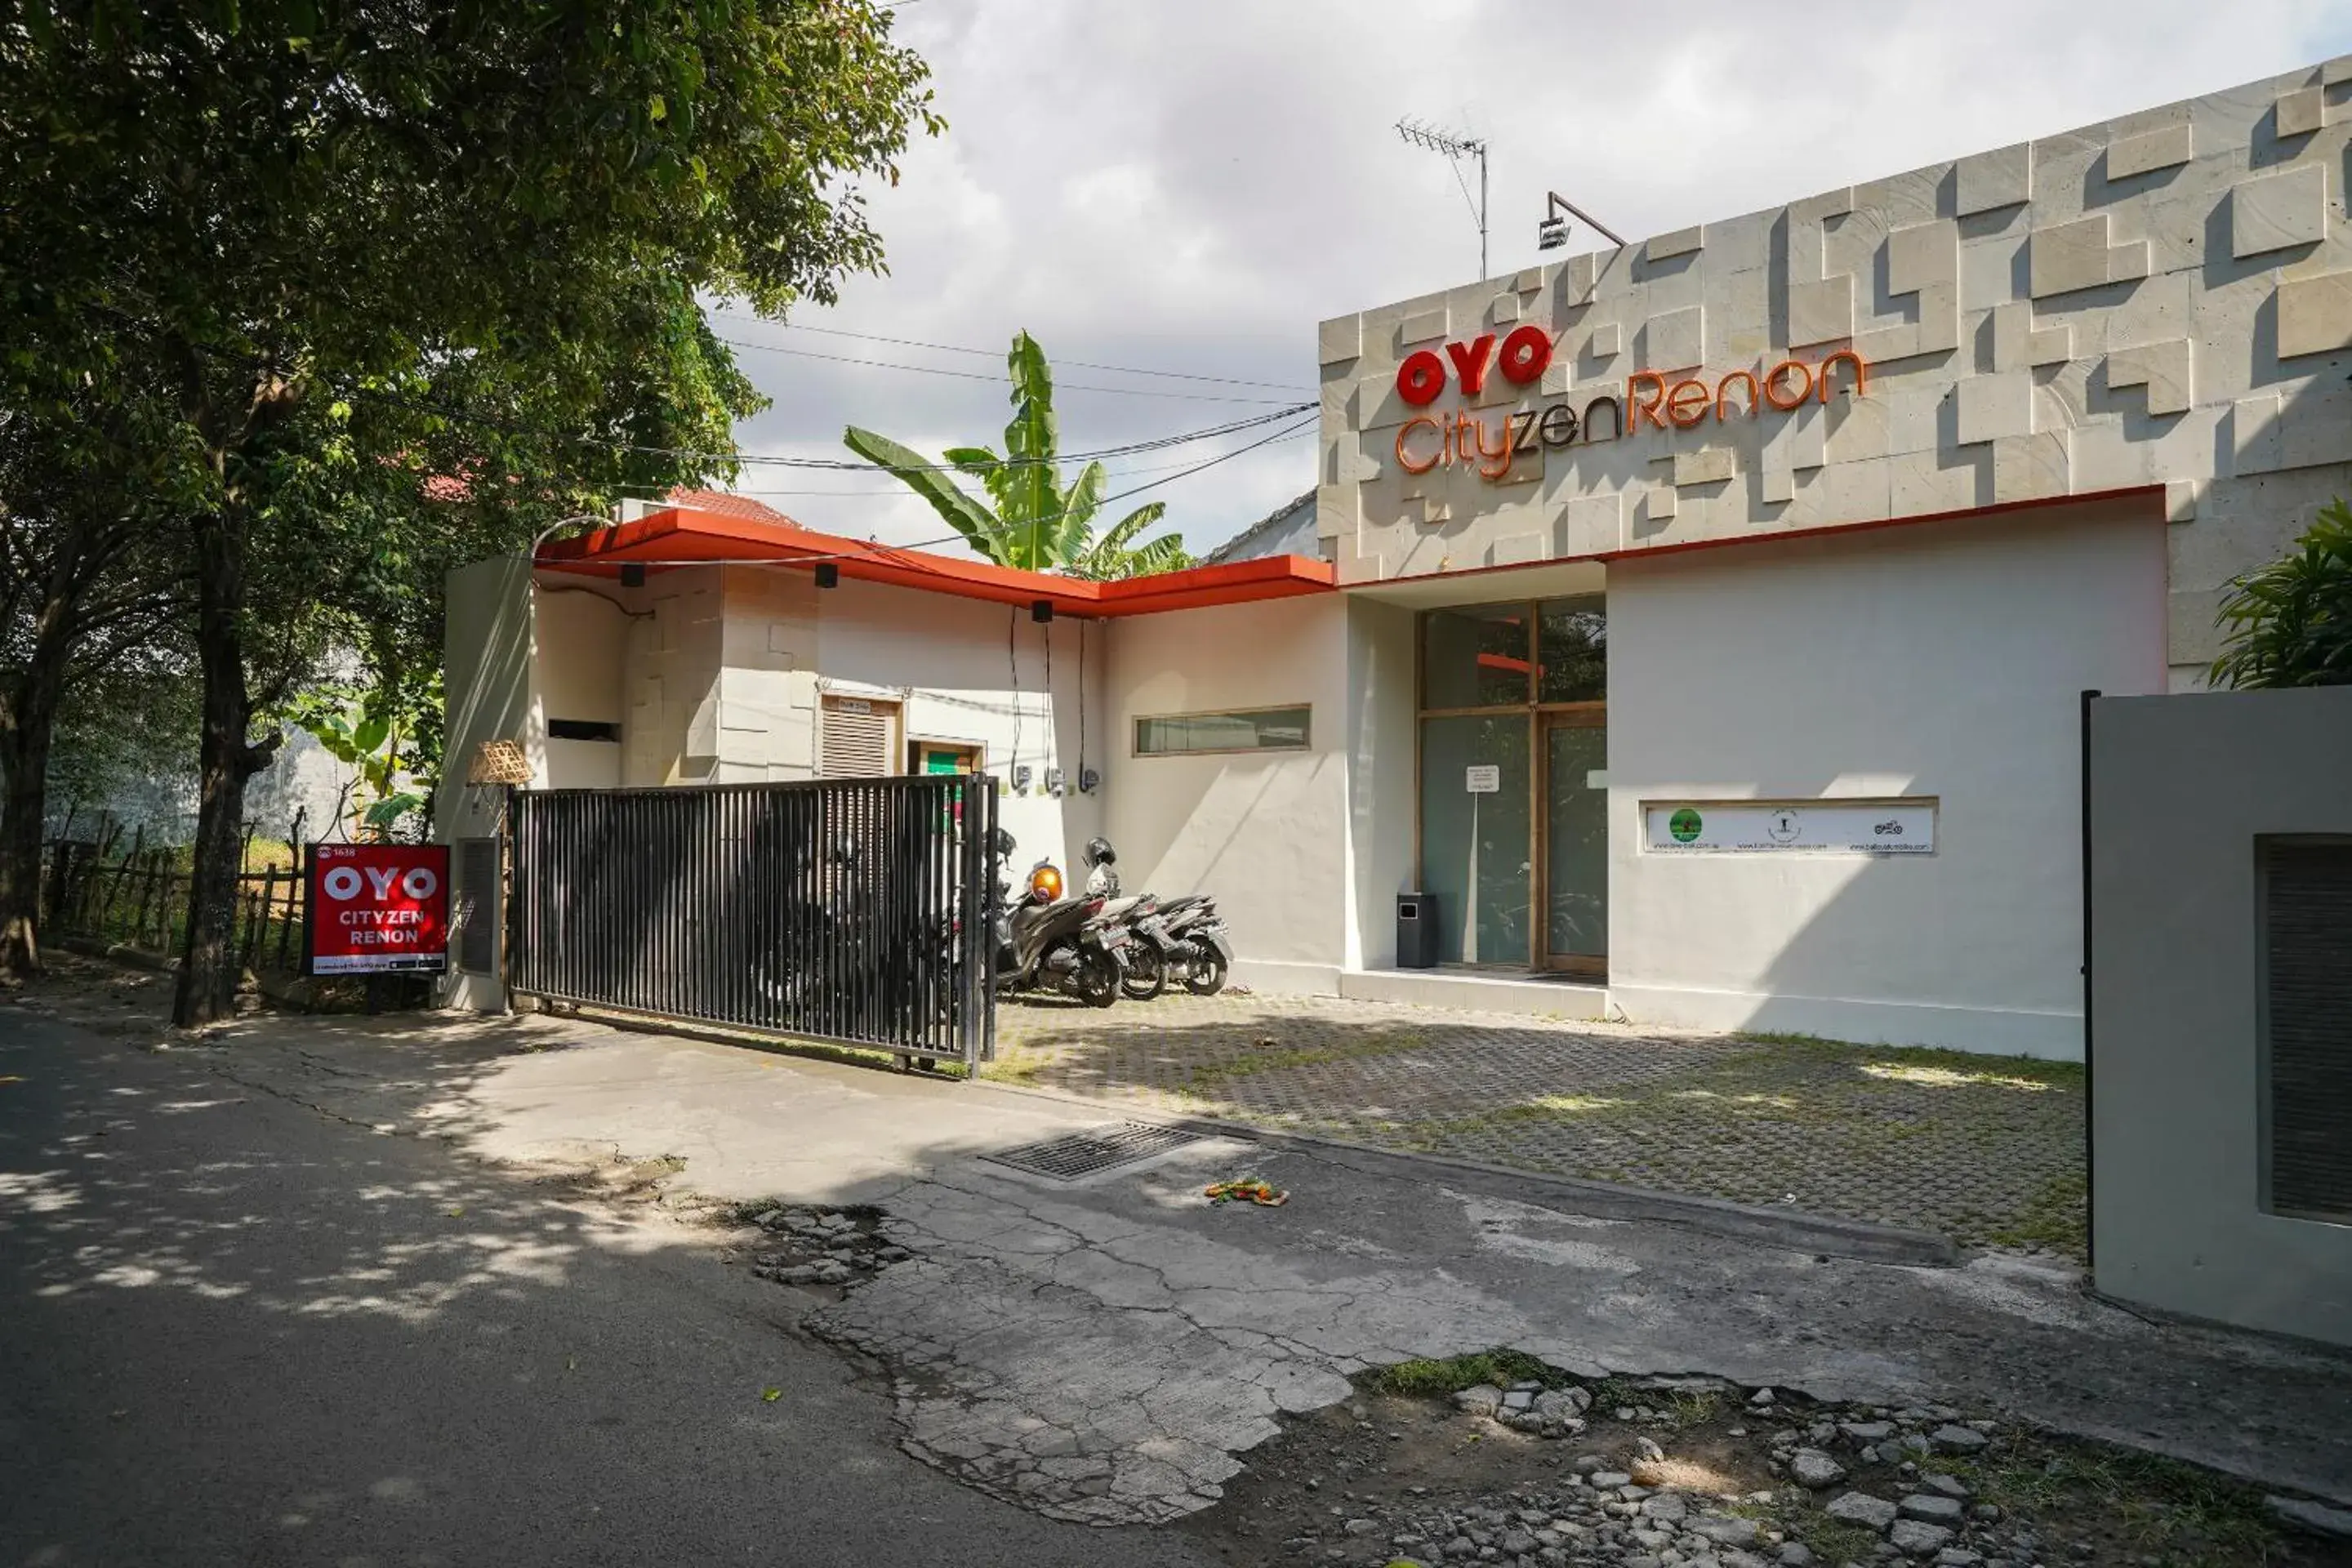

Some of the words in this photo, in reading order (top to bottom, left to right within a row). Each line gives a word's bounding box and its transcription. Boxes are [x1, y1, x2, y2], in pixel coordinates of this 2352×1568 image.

[1396, 326, 1552, 406] OYO
[324, 866, 437, 901] OYO
[340, 911, 424, 925] CITYZEN
[350, 929, 418, 944] RENON
